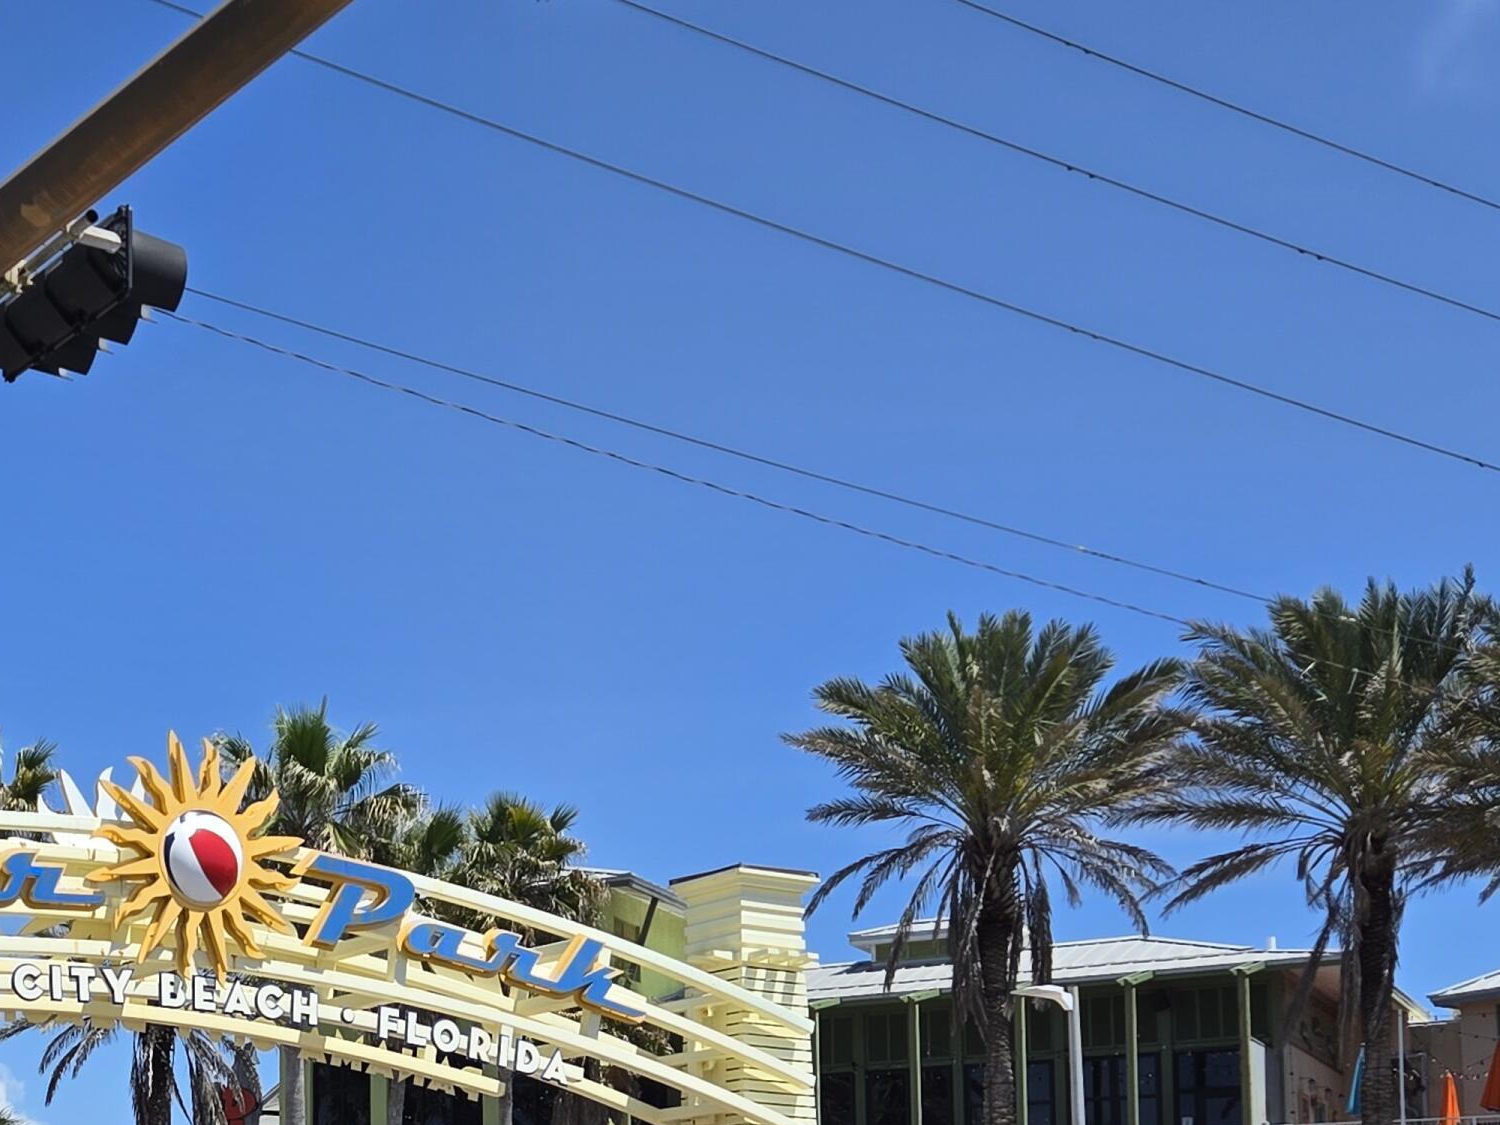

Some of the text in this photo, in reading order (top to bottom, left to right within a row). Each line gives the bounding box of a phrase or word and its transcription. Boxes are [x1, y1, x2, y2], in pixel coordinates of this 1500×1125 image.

[290, 851, 645, 1024] Park
[11, 963, 134, 1004] CITY
[156, 973, 319, 1026] BEACH
[377, 1005, 568, 1087] FLORIDA
